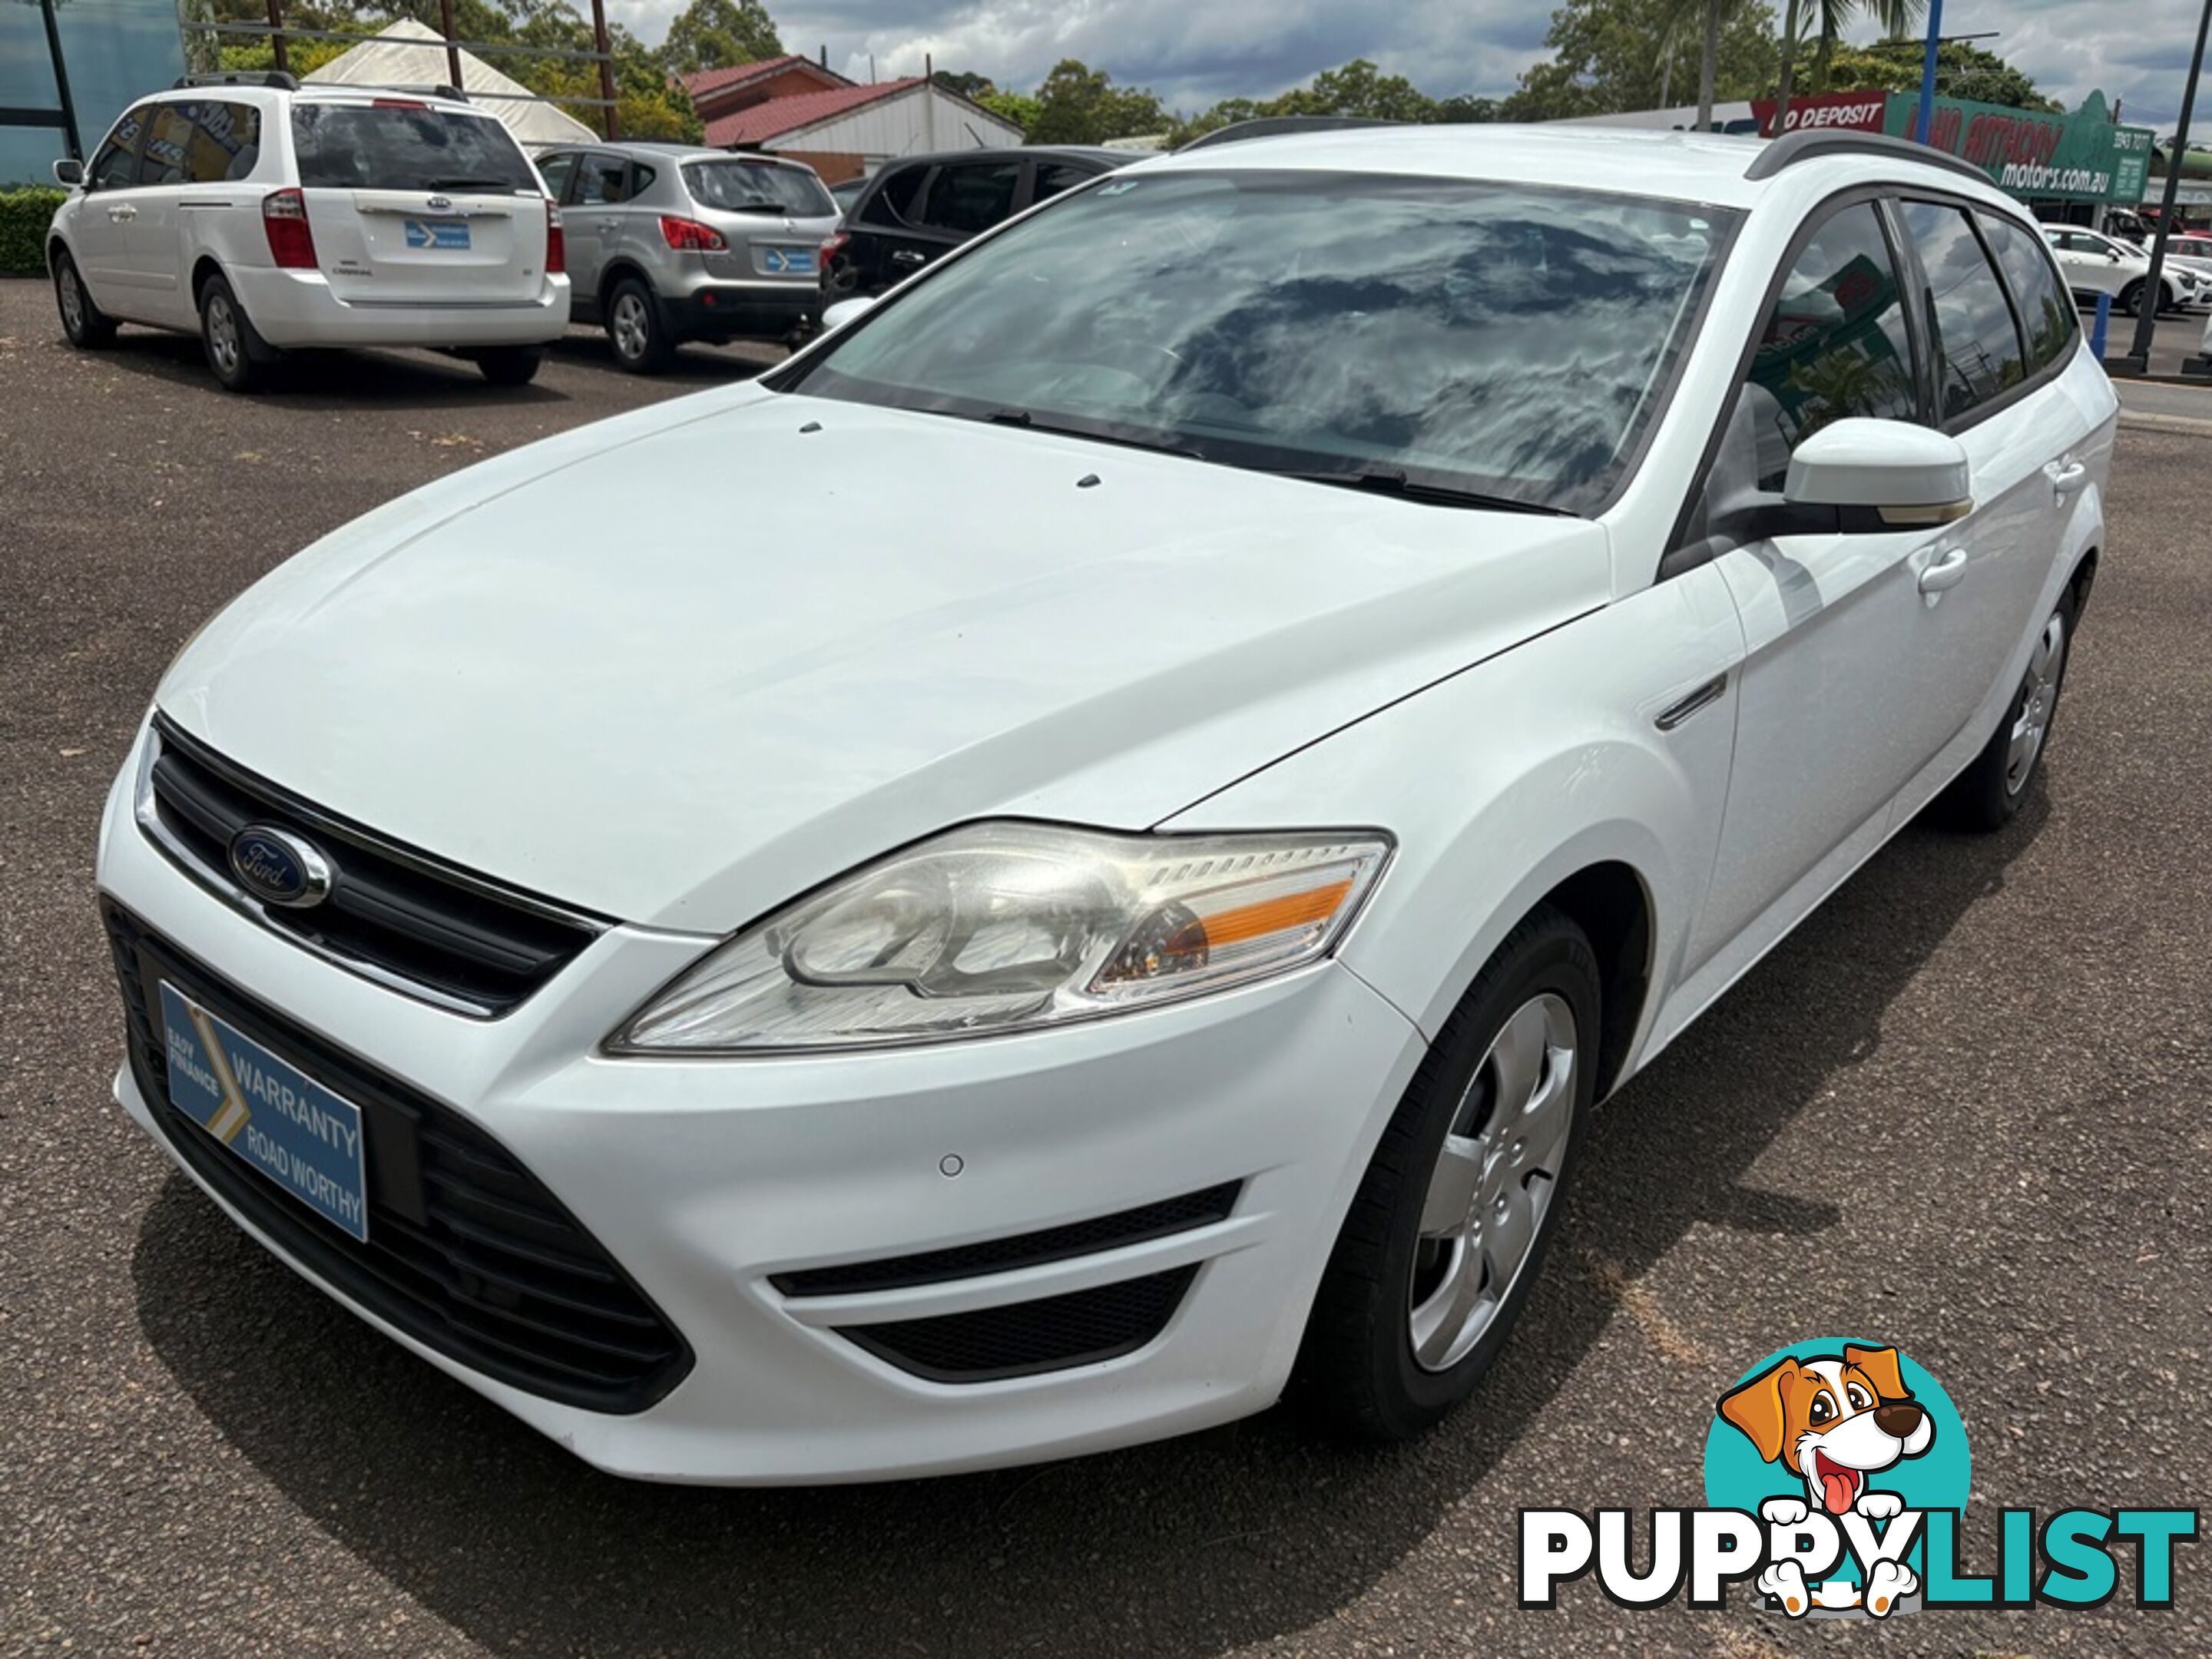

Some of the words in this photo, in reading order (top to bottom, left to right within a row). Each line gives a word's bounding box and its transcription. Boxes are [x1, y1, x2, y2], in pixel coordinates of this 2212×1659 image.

[1800, 102, 1883, 129] DEPOSIT
[2000, 157, 2111, 193] motors.com.au
[243, 843, 287, 886] Ford
[168, 1026, 194, 1059] EASY
[170, 1045, 219, 1098] FINANCE
[233, 1052, 356, 1159] WARRANTY
[247, 1124, 288, 1177] ROAD
[290, 1154, 360, 1224] WORTHY
